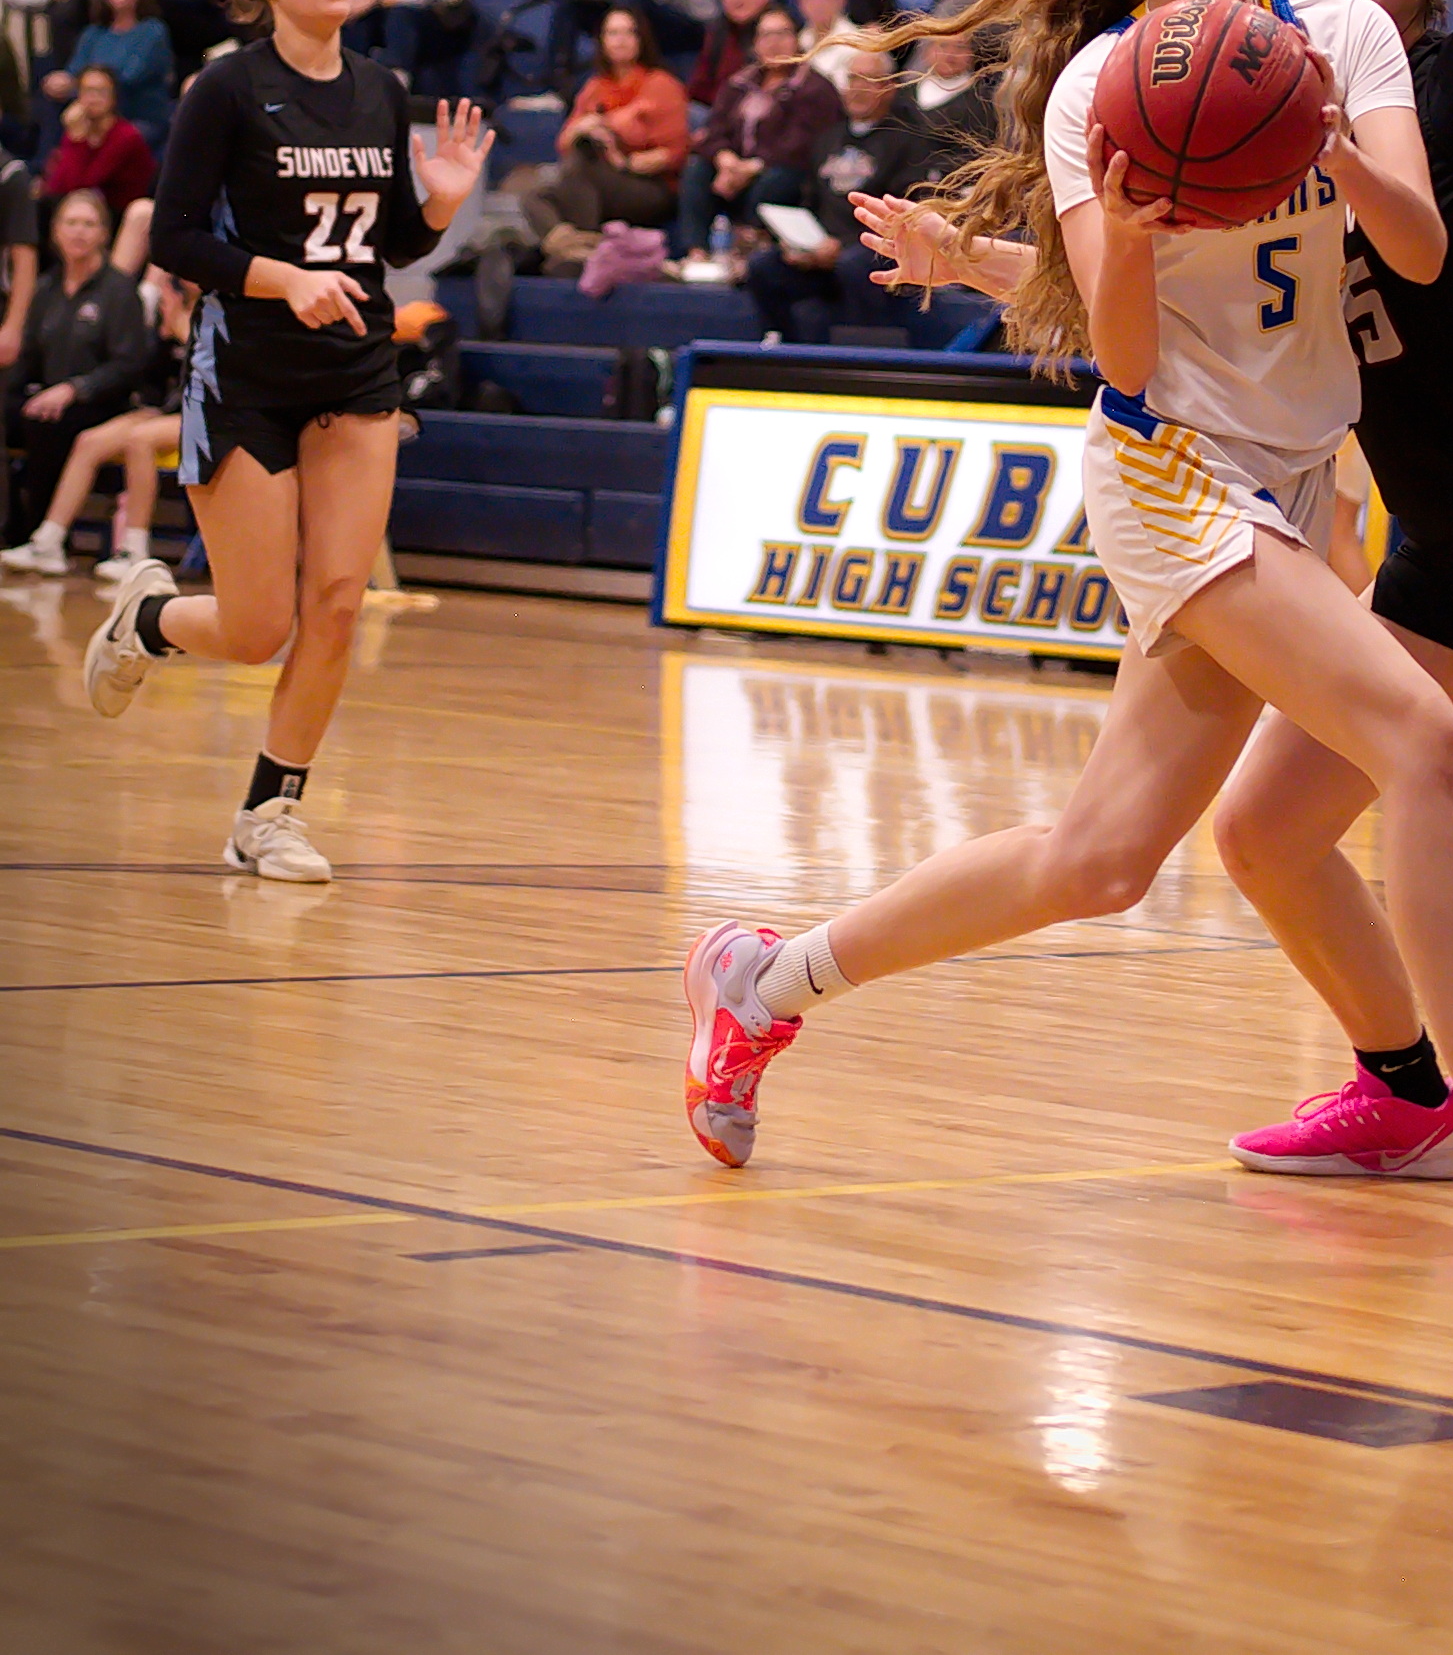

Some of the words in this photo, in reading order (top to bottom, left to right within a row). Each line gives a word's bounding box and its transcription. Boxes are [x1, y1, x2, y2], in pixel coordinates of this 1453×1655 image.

[276, 146, 394, 179] SUNDEVILS
[303, 191, 381, 264] 22
[1253, 232, 1301, 334] 5
[746, 540, 926, 616] HIGH
[934, 555, 1132, 634] SCHO
